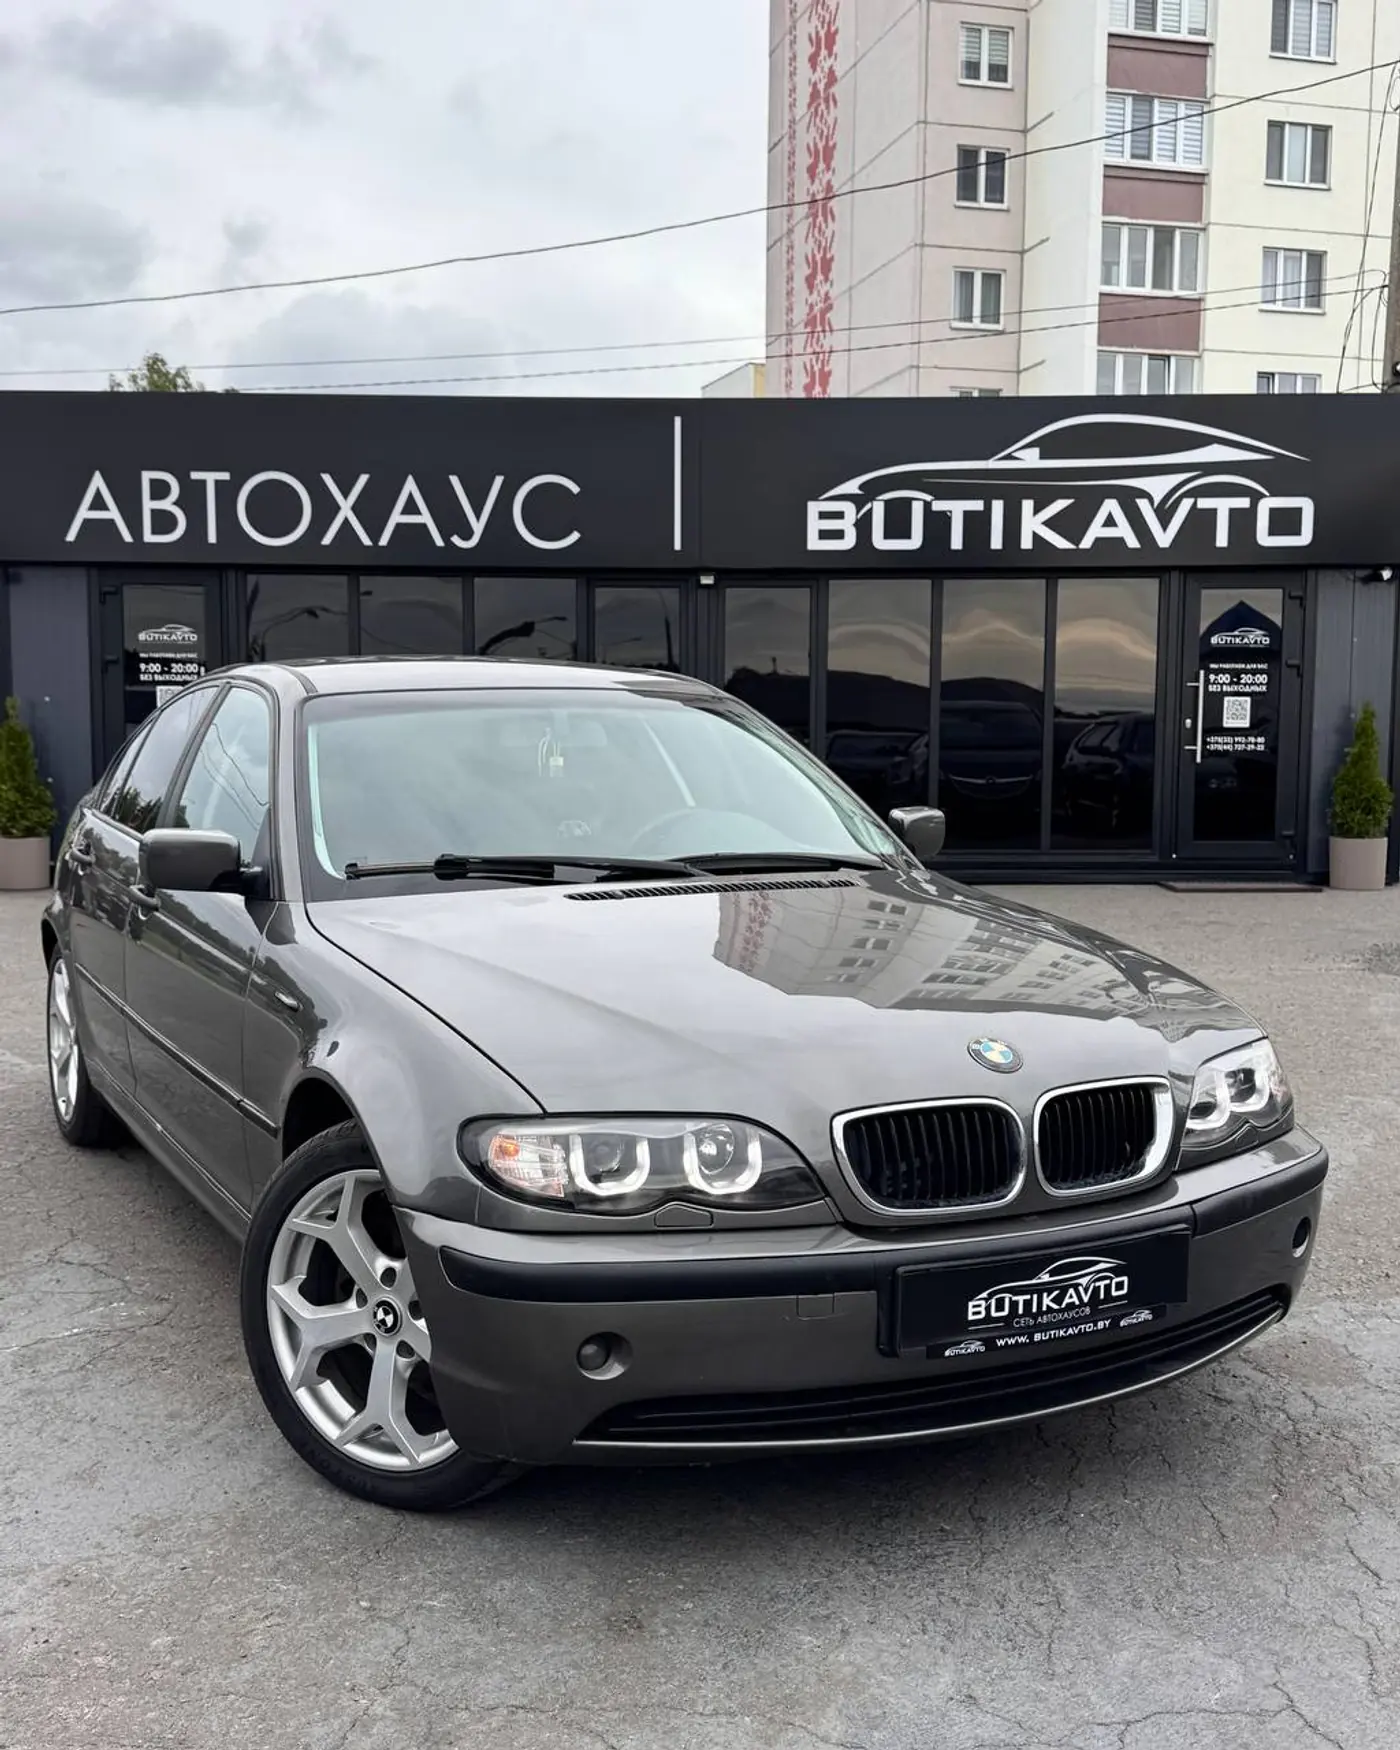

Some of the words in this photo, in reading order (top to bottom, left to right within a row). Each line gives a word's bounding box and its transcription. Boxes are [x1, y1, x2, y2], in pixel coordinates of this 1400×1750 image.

[66, 470, 581, 550] АВТОХАУС
[806, 496, 1315, 551] BUTIKAVTO
[138, 632, 198, 641] BUTIKAVTO
[1210, 635, 1270, 644] BUTIKAVTO
[139, 662, 161, 673] 9:00
[171, 662, 199, 673] 20:00
[1208, 673, 1231, 684] 9:00
[1240, 673, 1268, 684] 20:00
[967, 1275, 1129, 1321] BUTIKAVTO
